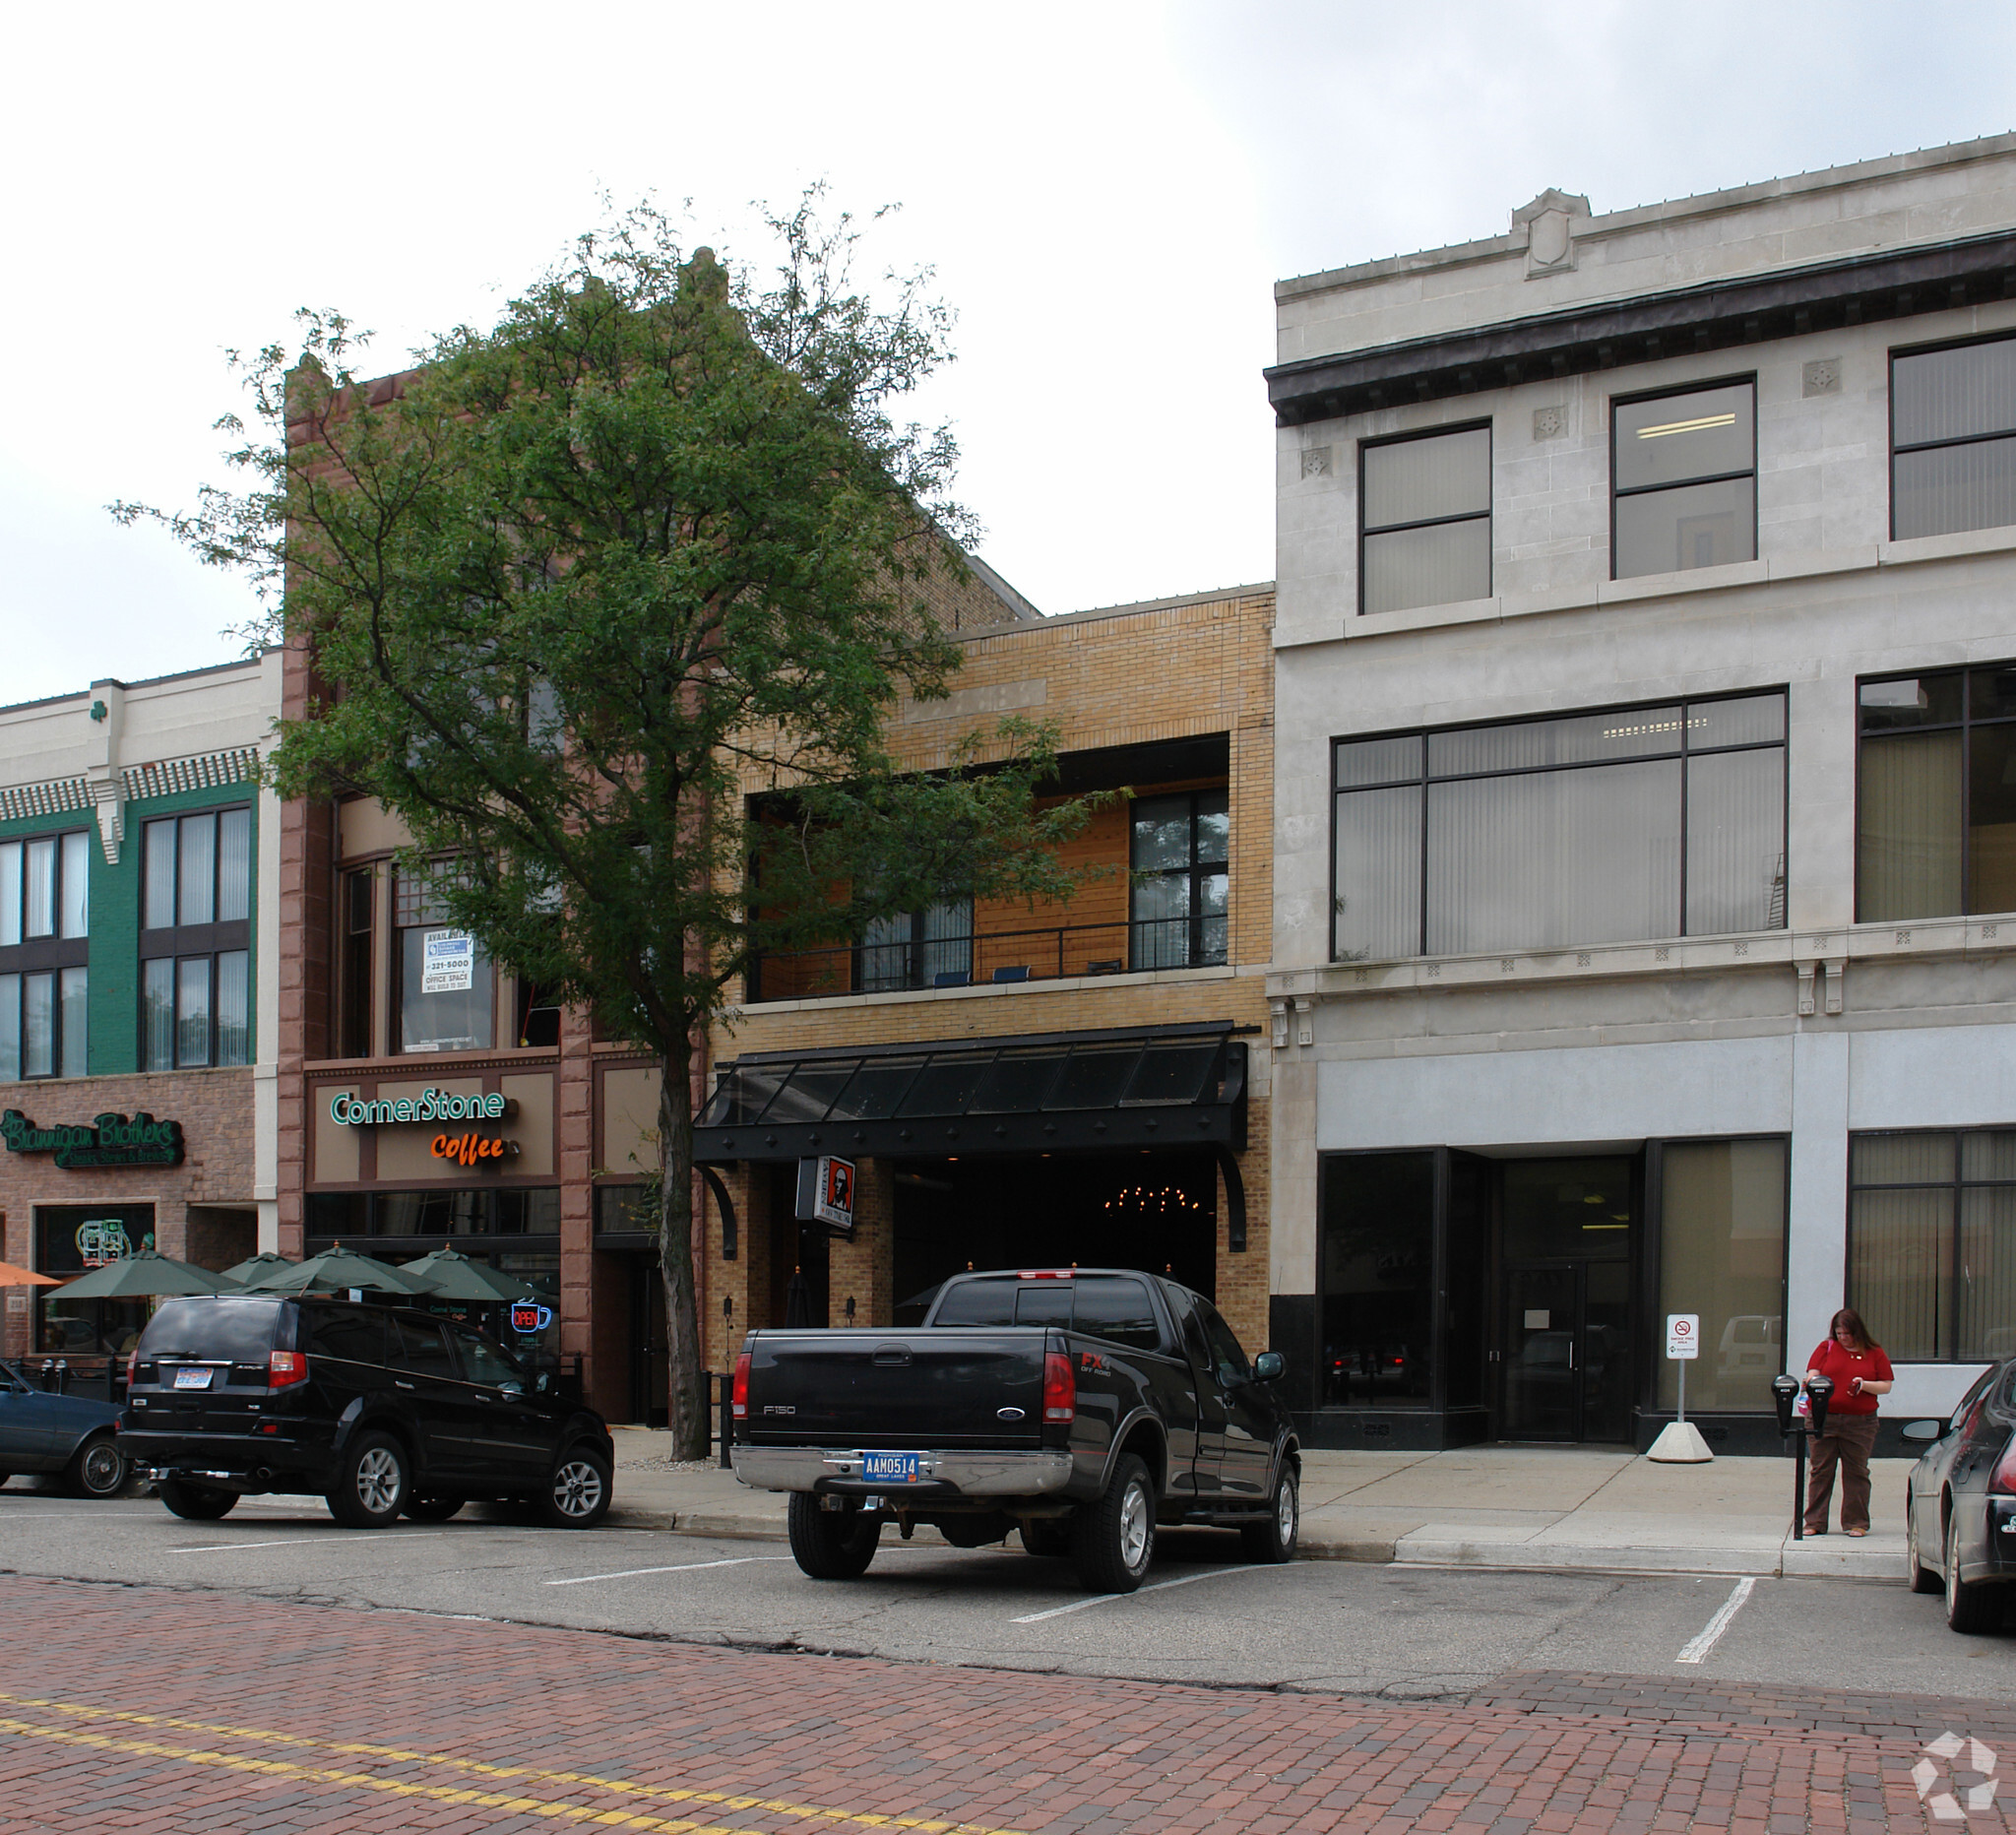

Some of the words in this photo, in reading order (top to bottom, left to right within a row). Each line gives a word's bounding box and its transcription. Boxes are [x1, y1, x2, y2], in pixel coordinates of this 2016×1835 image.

[431, 960, 469, 970] 321-5000
[449, 974, 468, 982] SPACE
[331, 1088, 505, 1125] CornerStone
[1, 1110, 94, 1154] Brannigan
[94, 1112, 174, 1147] Brothers
[430, 1133, 504, 1167] Coffee
[514, 1311, 538, 1325] OPEN
[1082, 1352, 1110, 1369] FX4
[1094, 1368, 1111, 1377] ROAD
[866, 1458, 915, 1473] AAM0514
